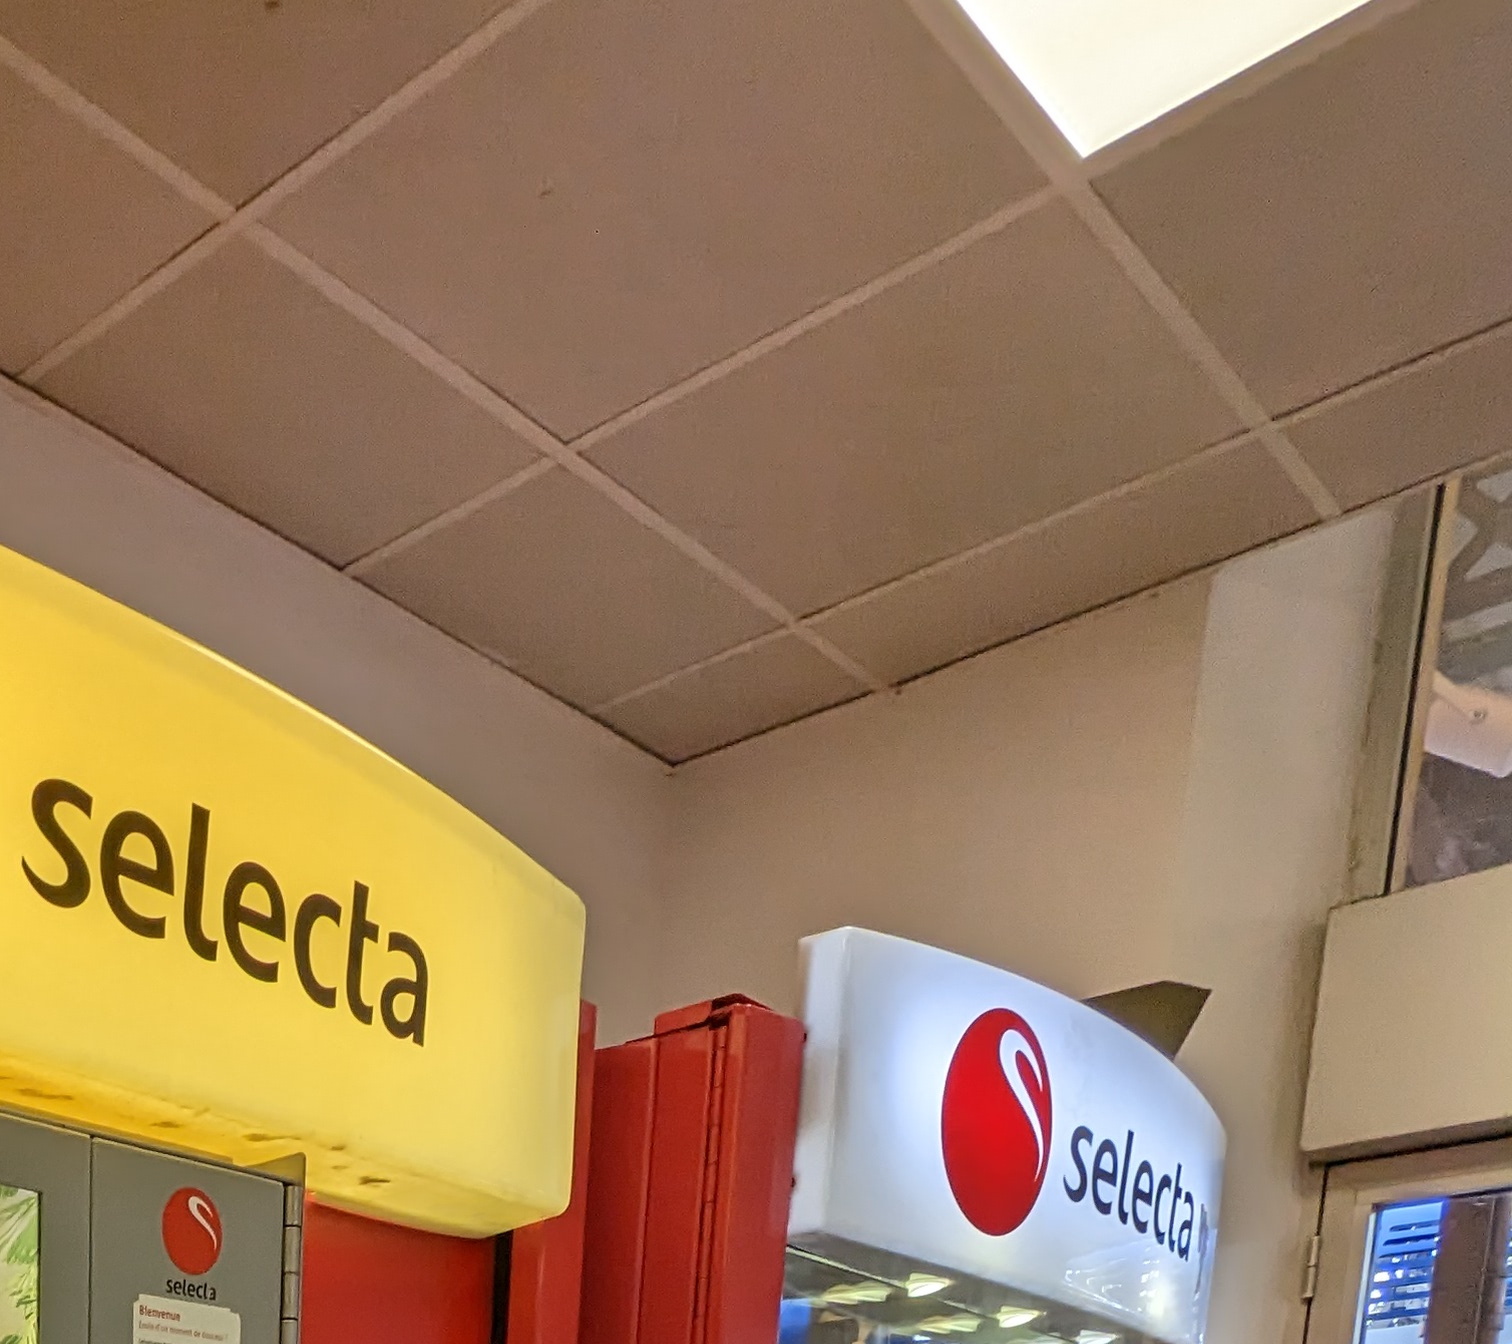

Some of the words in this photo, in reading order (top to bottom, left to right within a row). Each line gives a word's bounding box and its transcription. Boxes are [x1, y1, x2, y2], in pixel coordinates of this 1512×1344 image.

[21, 778, 429, 1047] selecta
[1063, 1125, 1195, 1262] selecta
[166, 1278, 216, 1301] selecta
